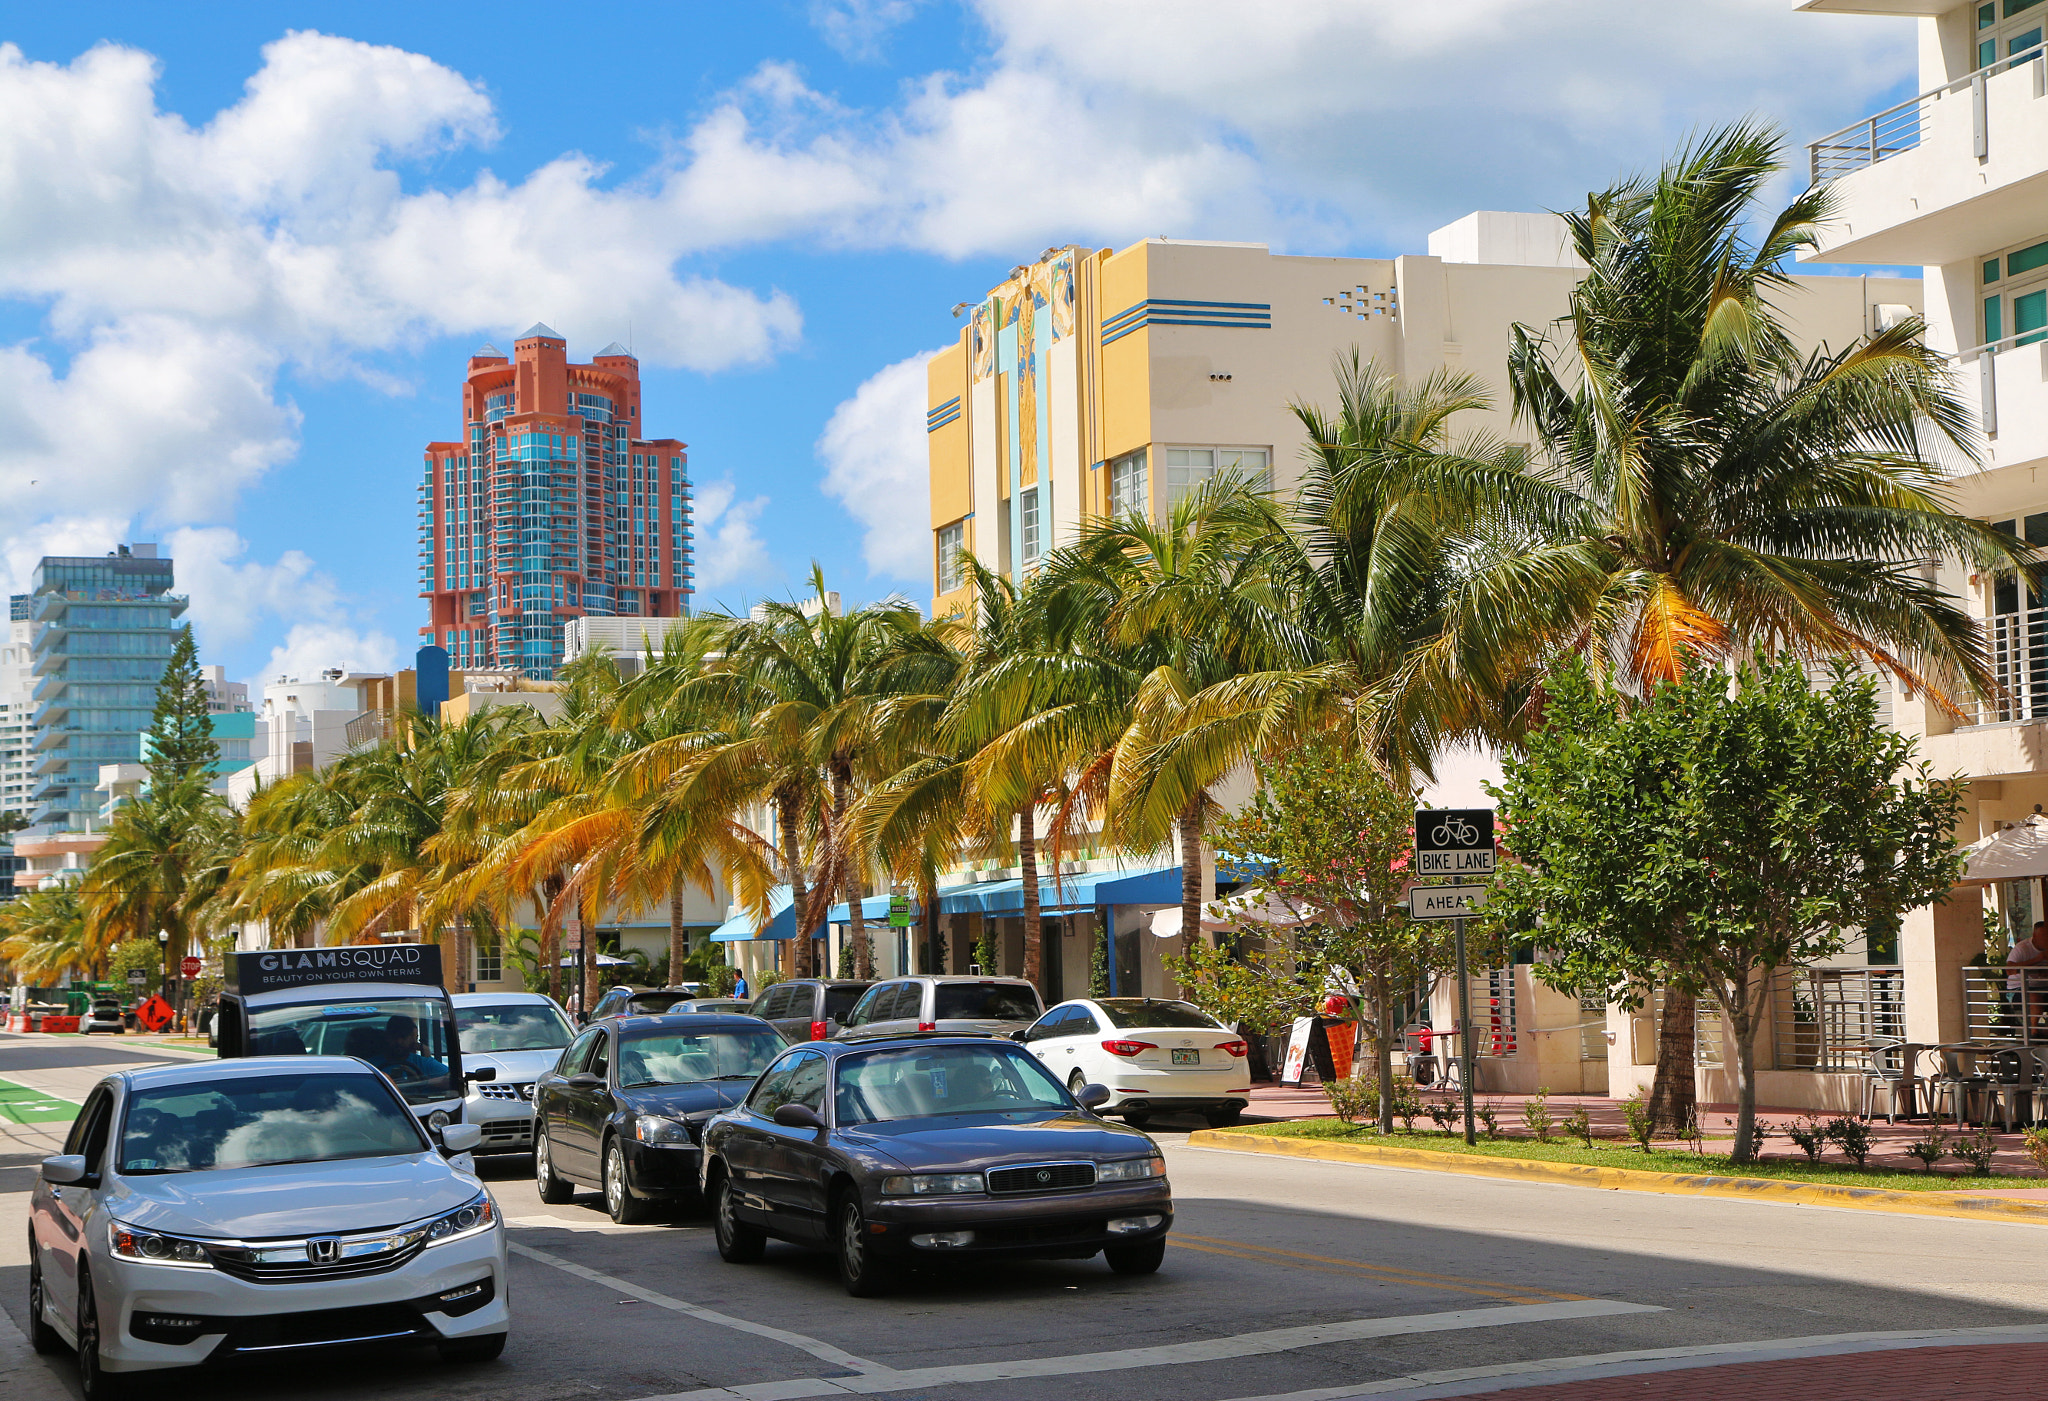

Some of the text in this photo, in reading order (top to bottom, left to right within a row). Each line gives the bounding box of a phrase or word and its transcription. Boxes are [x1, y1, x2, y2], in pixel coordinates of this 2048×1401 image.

[1422, 852, 1491, 870] BIKE LANE
[181, 962, 201, 971] STOP
[259, 948, 420, 971] GLAMSQUAD
[262, 967, 421, 984] BEAUTY ON YOUR OWN TERMS
